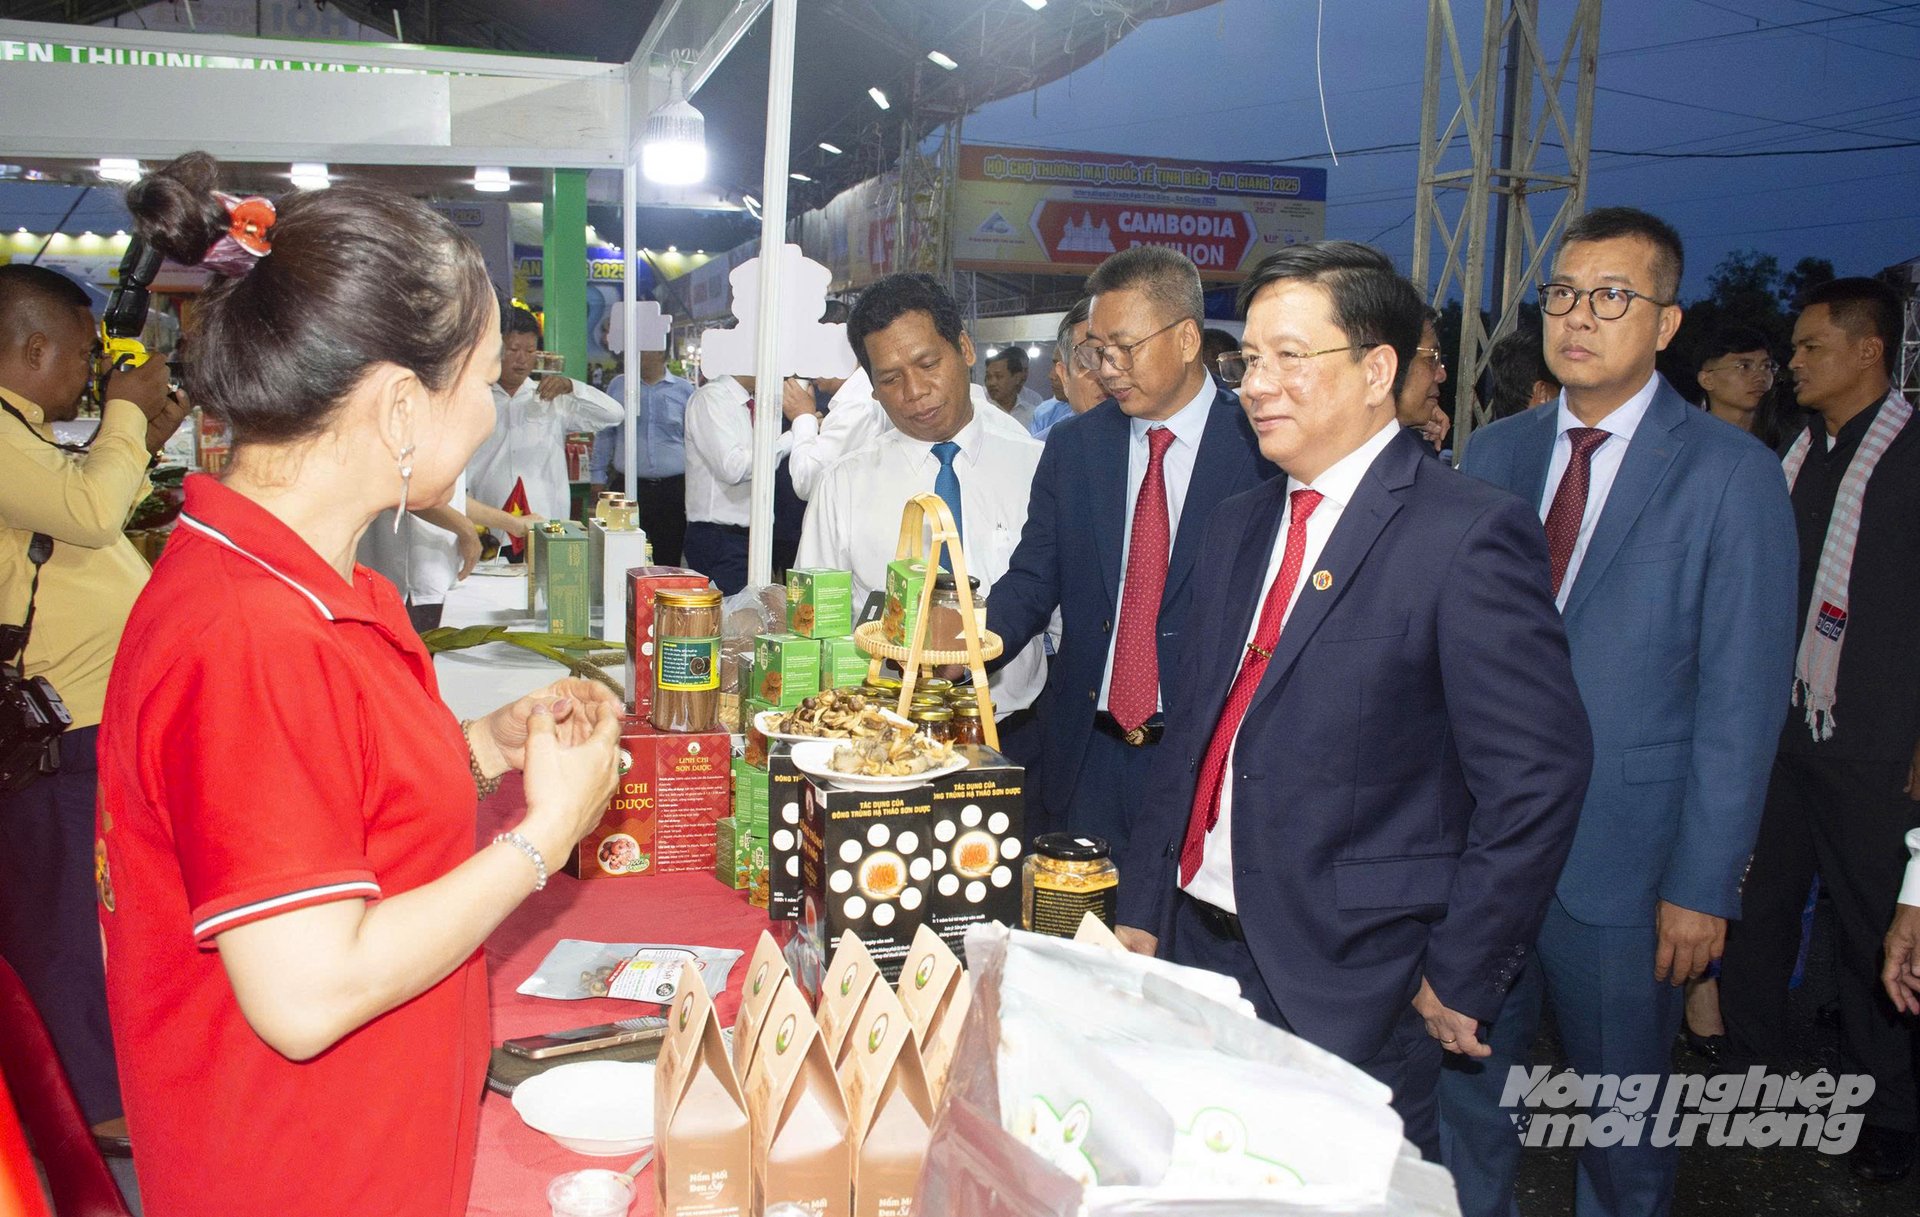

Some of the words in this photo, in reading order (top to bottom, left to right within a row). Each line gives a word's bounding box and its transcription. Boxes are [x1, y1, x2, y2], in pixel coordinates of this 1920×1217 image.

[1219, 173, 1234, 187] AN
[1238, 175, 1269, 190] GIANG
[1272, 178, 1298, 191] 2025
[1118, 211, 1236, 238] CAMBODIA
[696, 756, 709, 764] CHI
[624, 783, 648, 795] CHI
[616, 797, 654, 811] DƯỢC
[859, 800, 873, 810] TÁC
